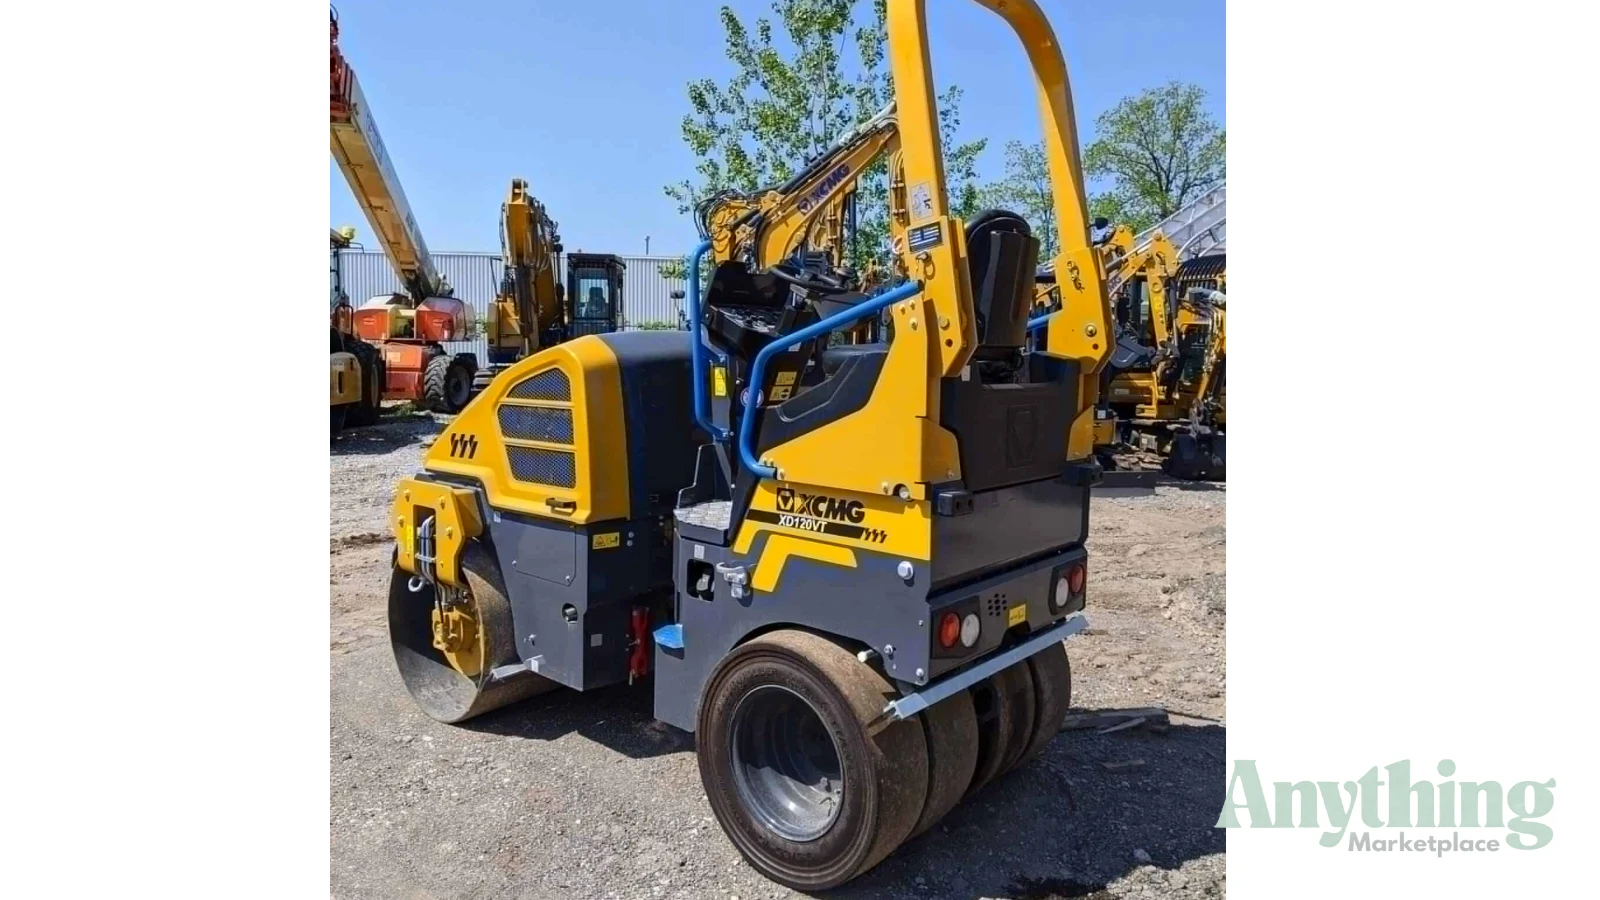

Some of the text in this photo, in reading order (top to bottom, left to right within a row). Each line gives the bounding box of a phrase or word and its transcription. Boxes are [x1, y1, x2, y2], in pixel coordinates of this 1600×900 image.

[809, 163, 850, 204] XCMG
[778, 514, 828, 534] XD120VT
[796, 493, 865, 524] XCMG
